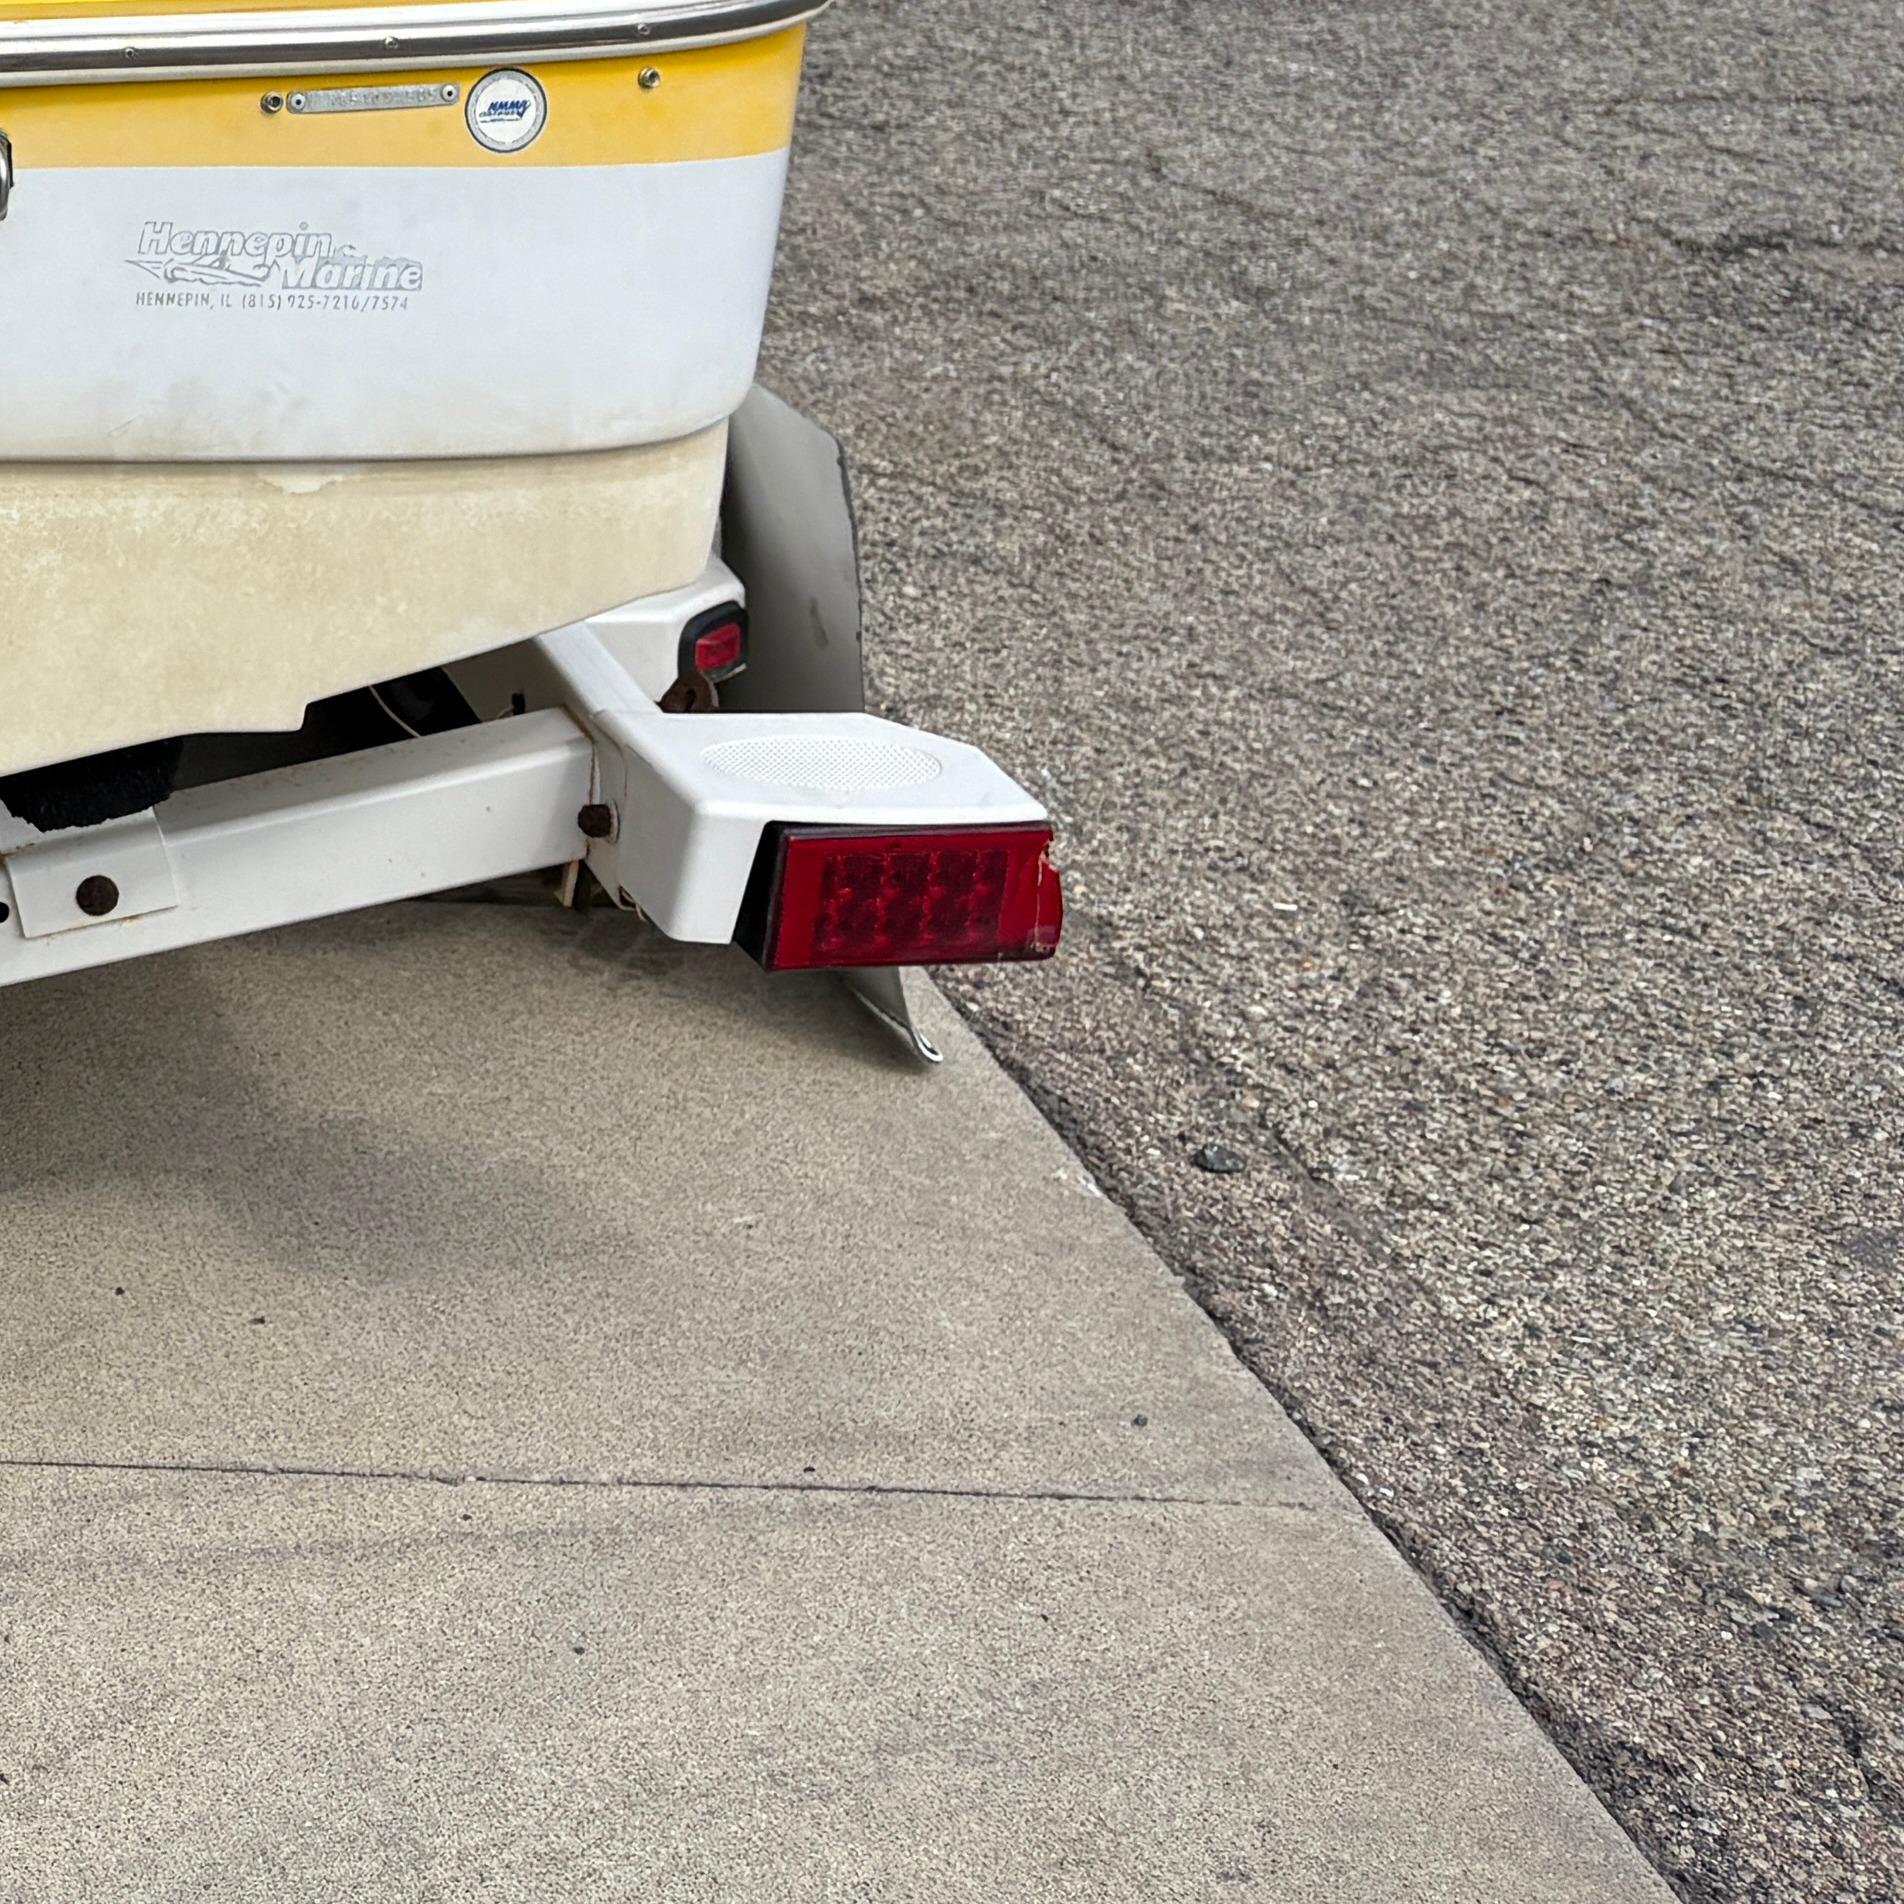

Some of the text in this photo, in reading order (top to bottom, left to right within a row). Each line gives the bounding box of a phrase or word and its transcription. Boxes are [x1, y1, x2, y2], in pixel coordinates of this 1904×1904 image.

[137, 221, 333, 267] Hennepin
[281, 253, 424, 291] Marine
[135, 291, 215, 310] HENNEPIN,
[220, 293, 233, 308] IL
[242, 294, 282, 311] (815)
